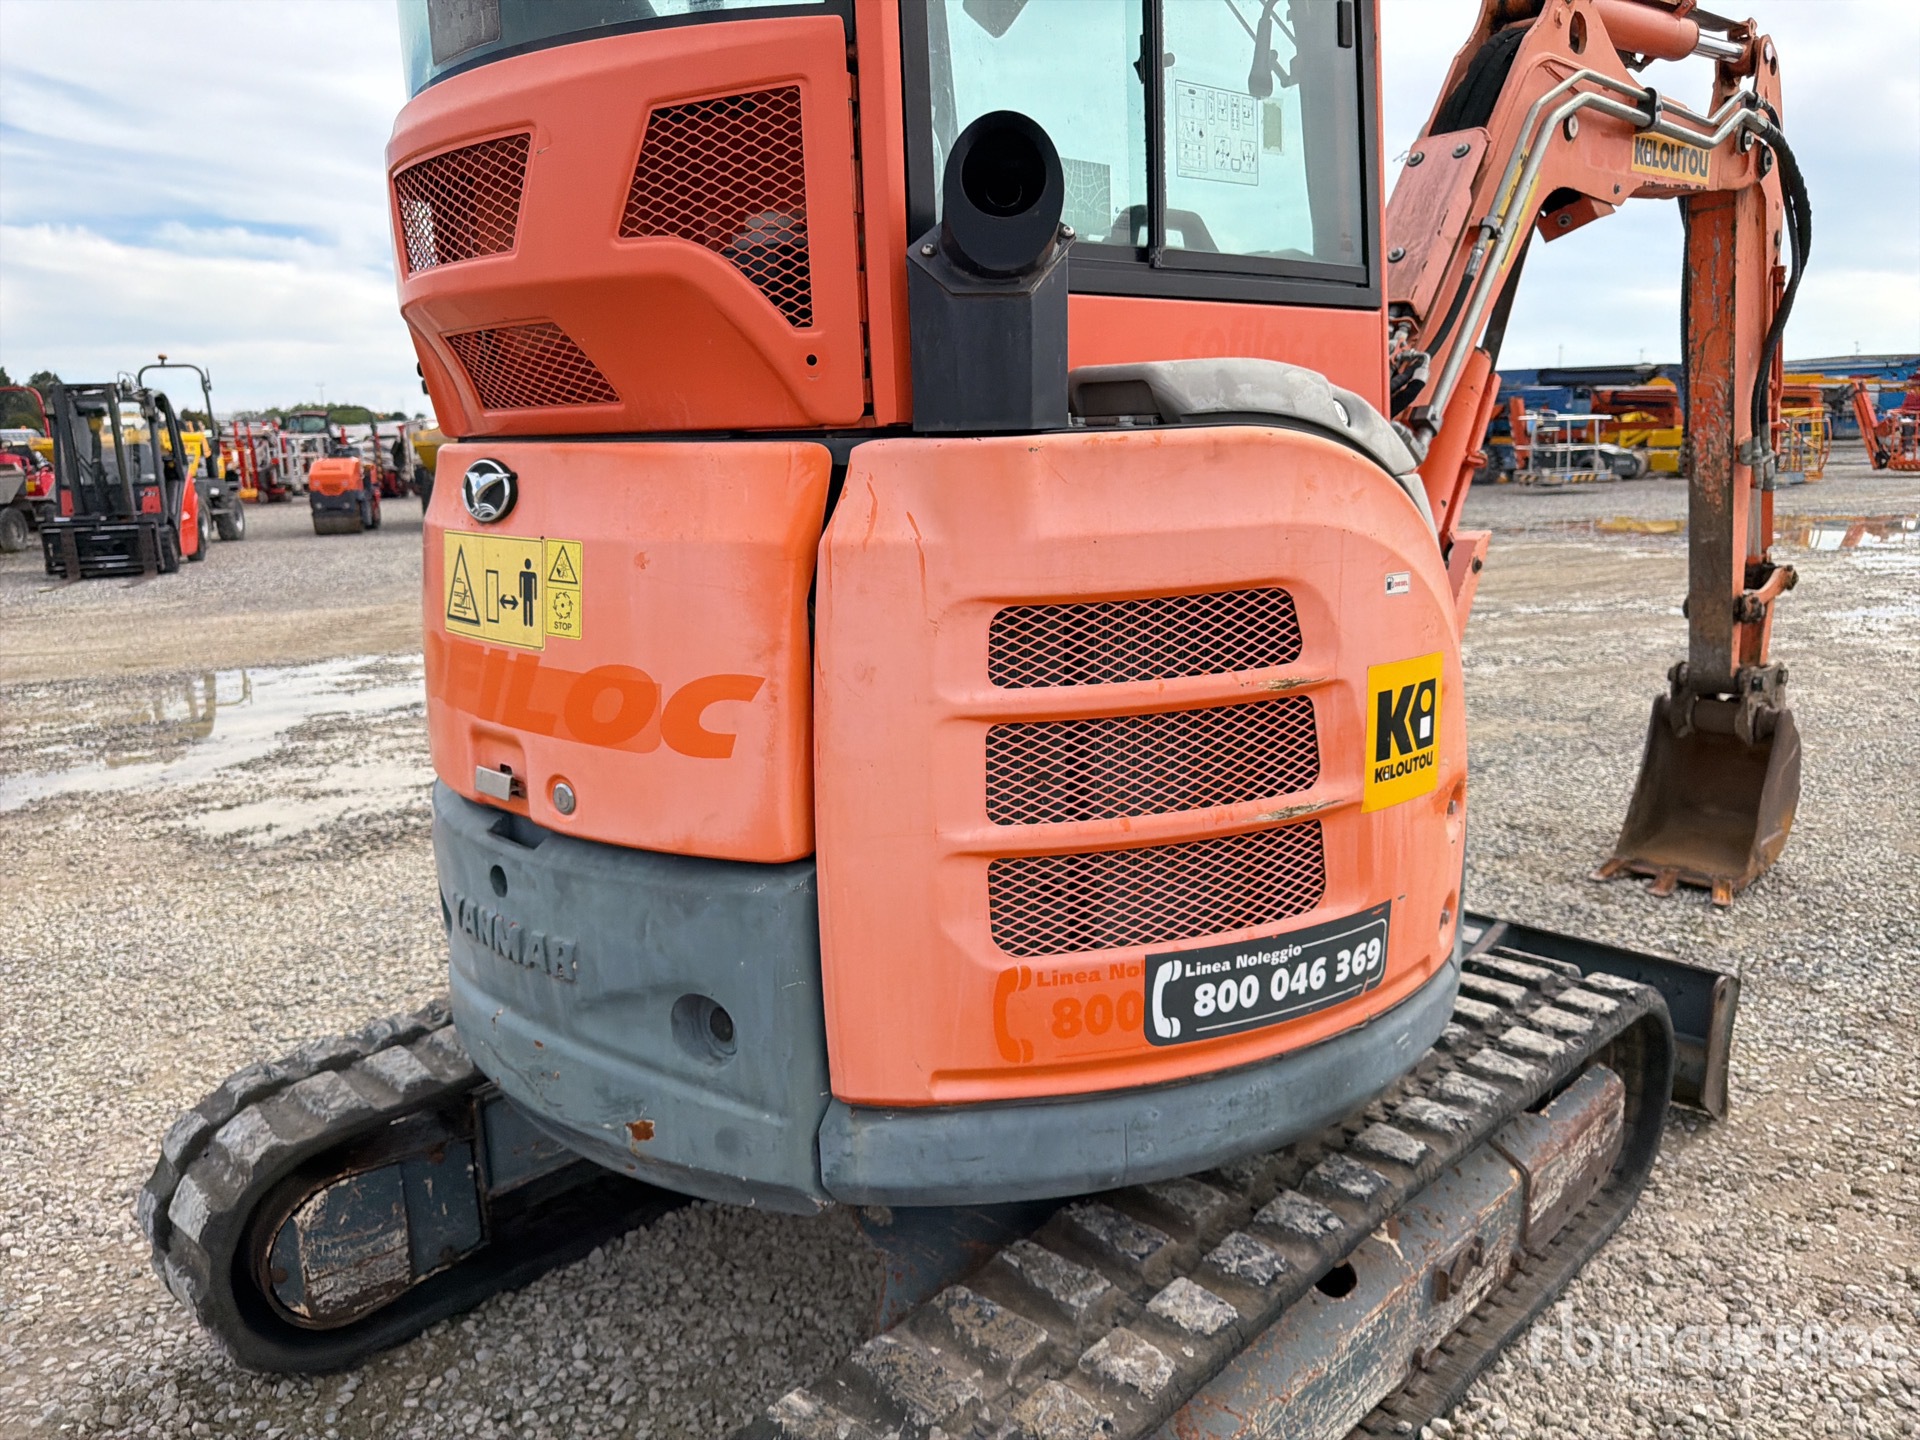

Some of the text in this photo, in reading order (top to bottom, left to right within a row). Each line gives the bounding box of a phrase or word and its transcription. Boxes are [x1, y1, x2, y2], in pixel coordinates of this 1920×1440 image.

[554, 621, 573, 631] STOP
[453, 892, 578, 984] YANMAR
[1036, 965, 1102, 987] Linea
[1185, 943, 1303, 978] Linea Noleggio
[1193, 938, 1382, 1017] 800 046 369
[1051, 991, 1144, 1040] 800
